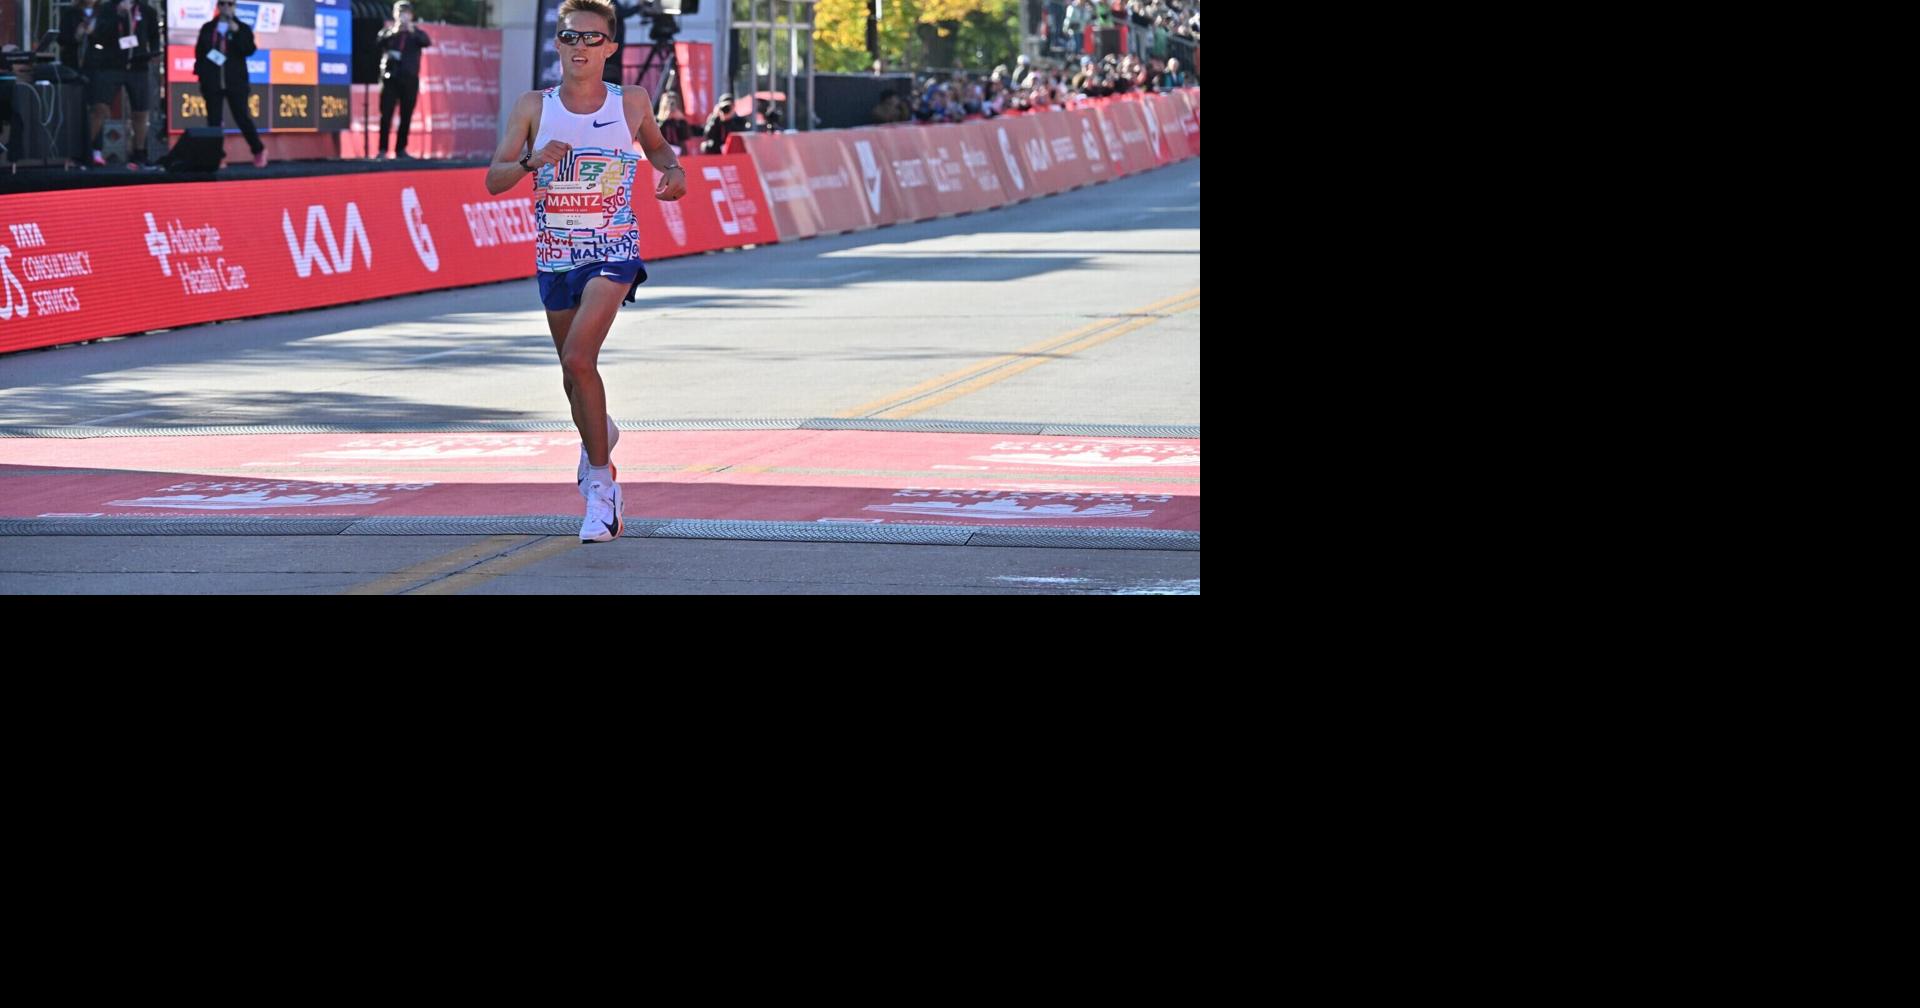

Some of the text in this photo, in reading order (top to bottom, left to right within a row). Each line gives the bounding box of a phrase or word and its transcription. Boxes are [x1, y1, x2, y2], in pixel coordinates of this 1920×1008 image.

[547, 195, 601, 207] MANTZ
[8, 222, 46, 248] TATA
[166, 218, 223, 254] Advocate
[22, 251, 93, 282] CONSULTANCY
[176, 256, 249, 295] Health Care
[32, 286, 80, 316] SERVICES
